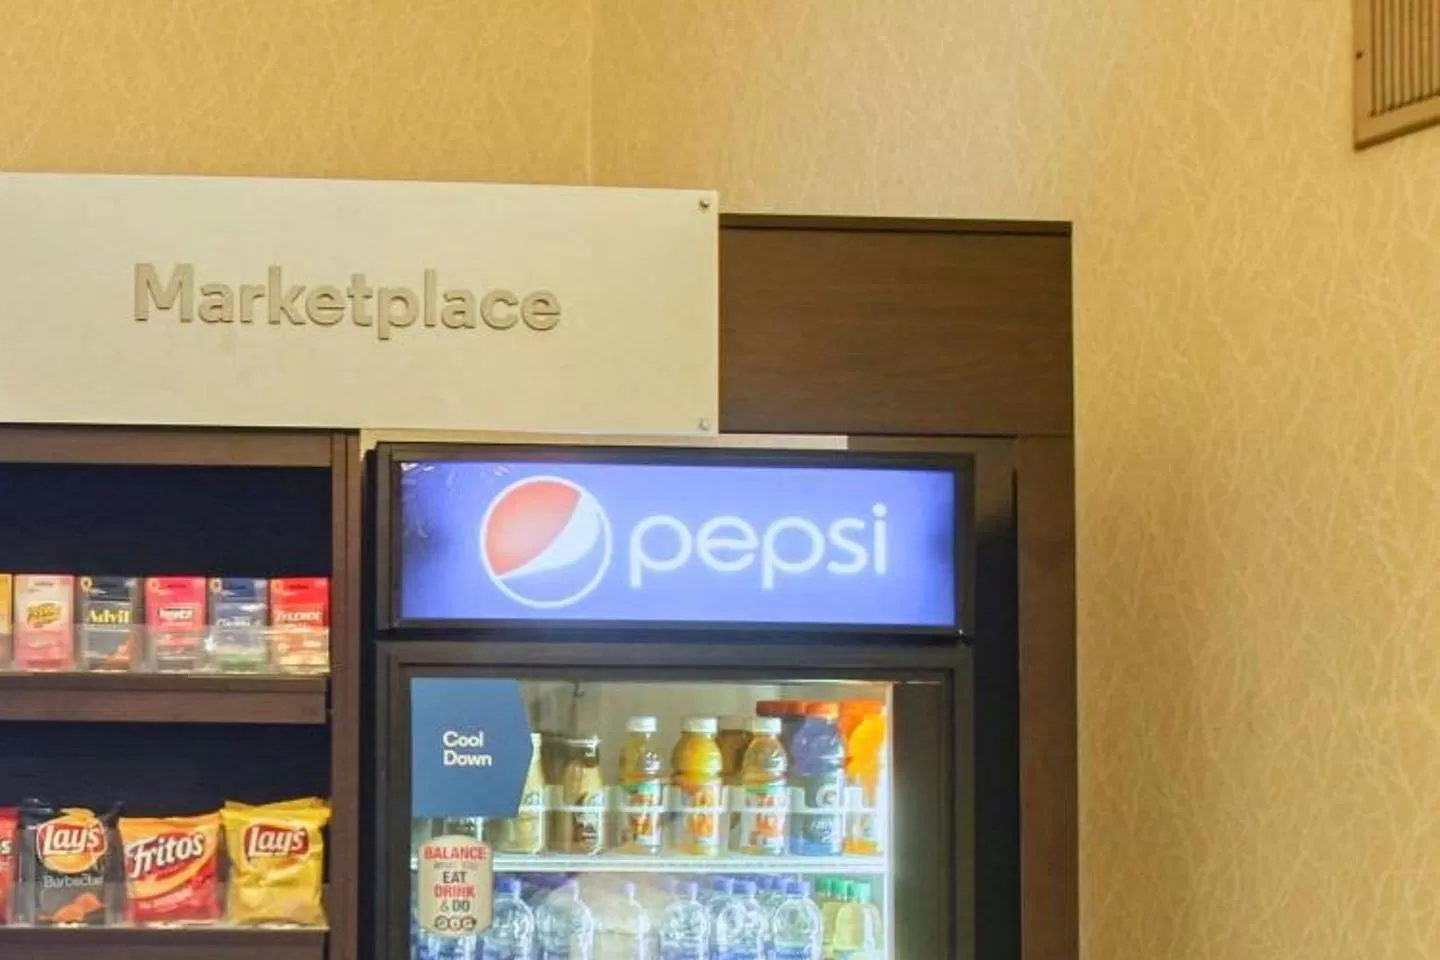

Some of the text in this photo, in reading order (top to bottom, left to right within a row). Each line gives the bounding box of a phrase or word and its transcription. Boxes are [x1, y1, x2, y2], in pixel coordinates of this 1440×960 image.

[133, 262, 562, 340] Marketplace
[628, 503, 887, 589] pepsi
[89, 609, 130, 624] Advil
[442, 731, 485, 748] Cool
[443, 751, 493, 766] Down
[41, 825, 102, 857] Lay's
[247, 826, 305, 857] Lay's
[126, 831, 206, 879] Fritos
[423, 846, 487, 860] BALANCE
[442, 871, 468, 884] EAT
[435, 885, 476, 898] DRINK
[452, 900, 471, 912] DO
